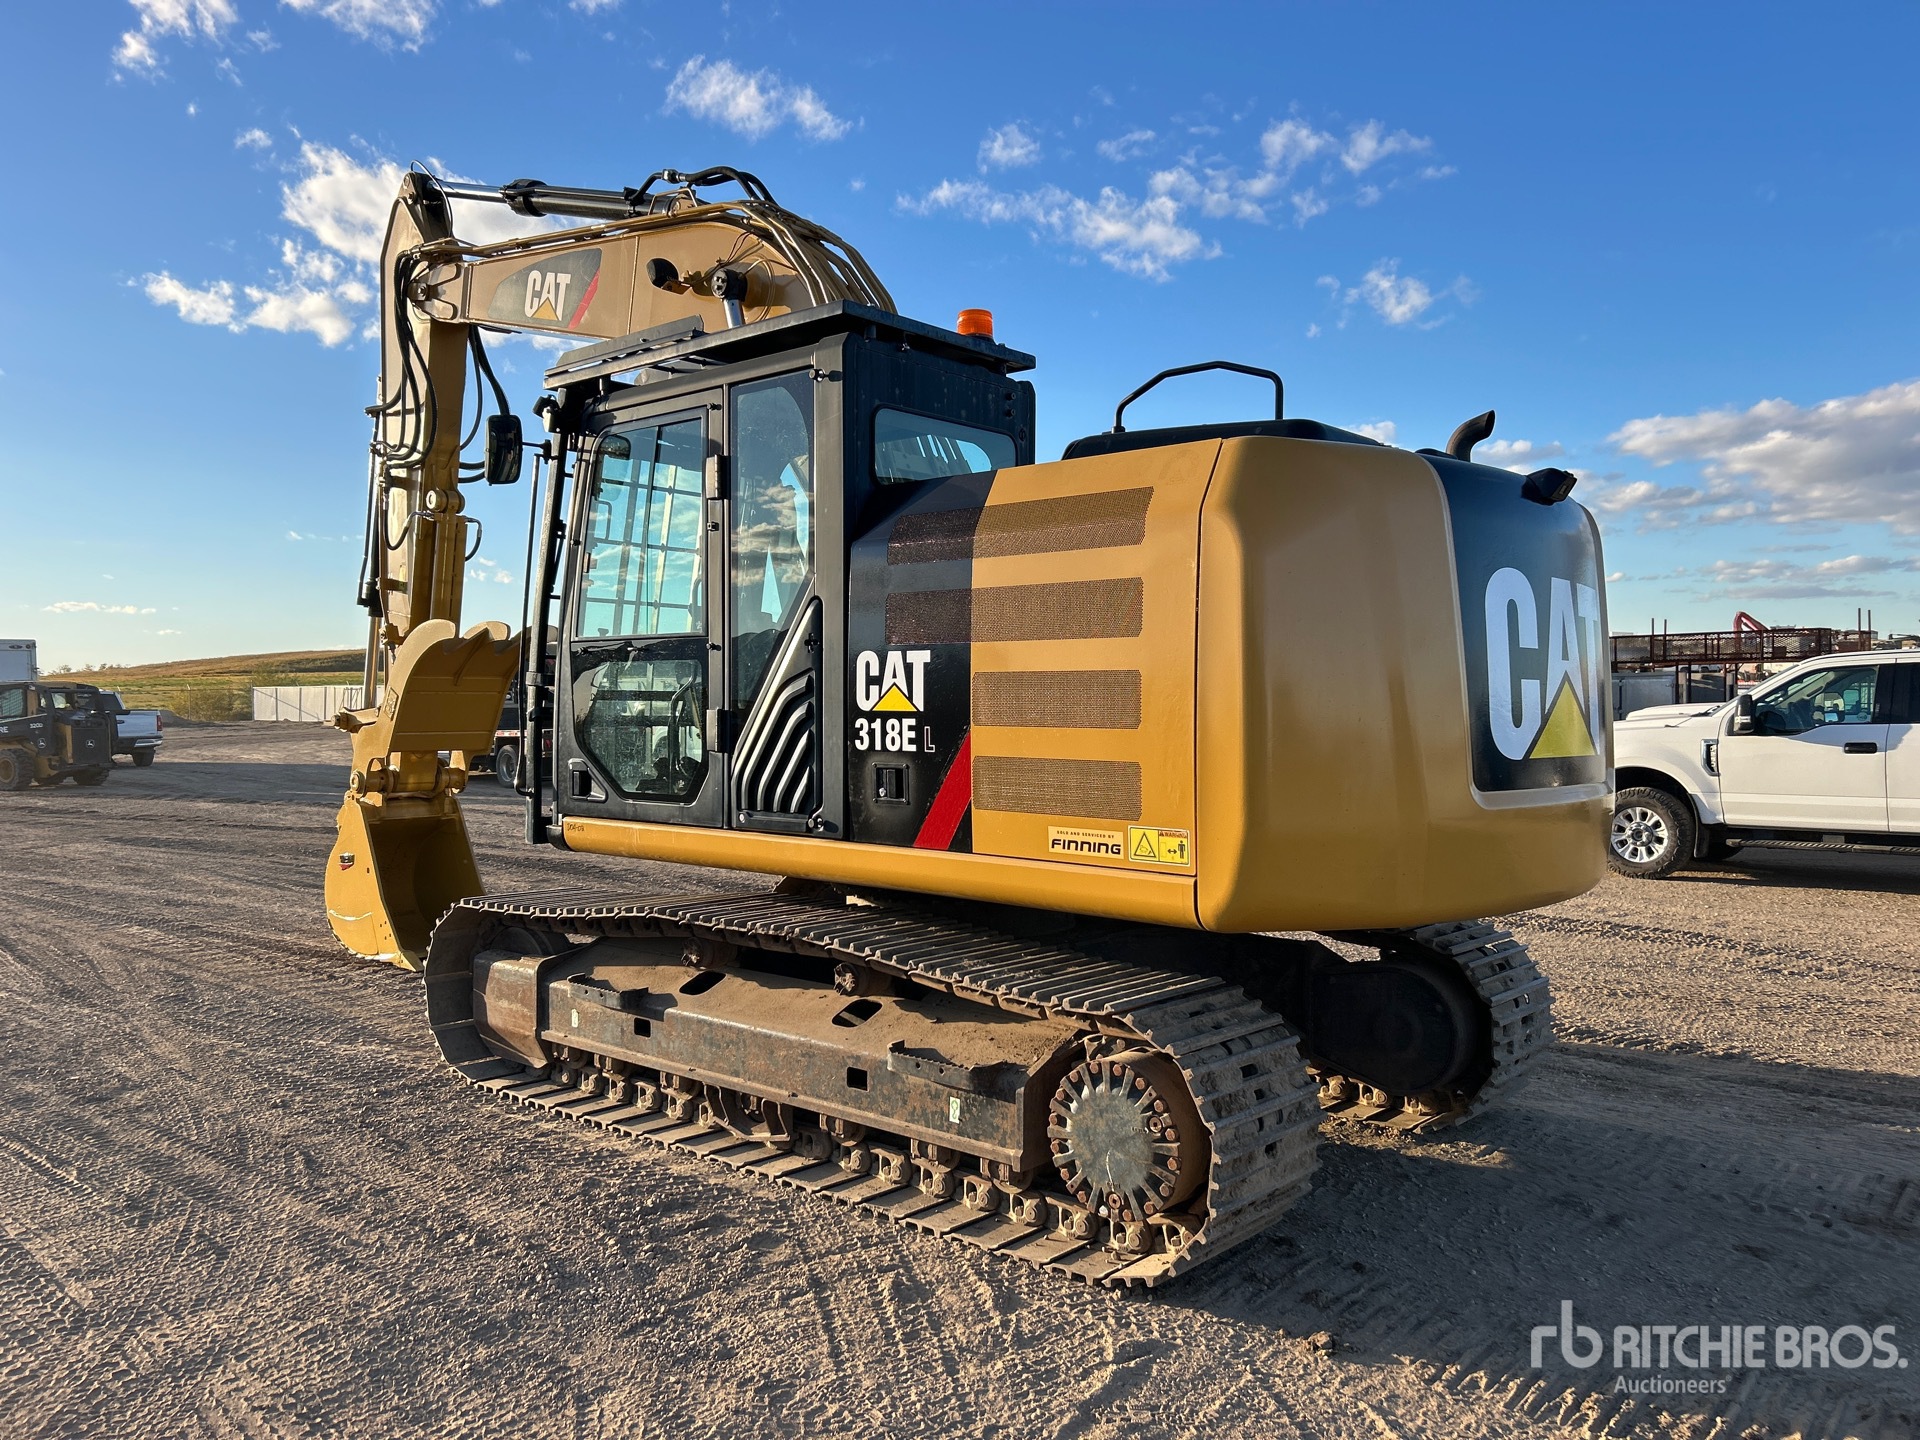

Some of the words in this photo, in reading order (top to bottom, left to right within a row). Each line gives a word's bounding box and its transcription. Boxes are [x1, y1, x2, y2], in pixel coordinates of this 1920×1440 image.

[525, 270, 571, 321] CAT
[856, 650, 931, 712] CAT
[1485, 567, 1602, 761] CAT
[854, 718, 917, 752] 318E
[924, 725, 936, 753] L
[1051, 838, 1122, 855] FINNING
